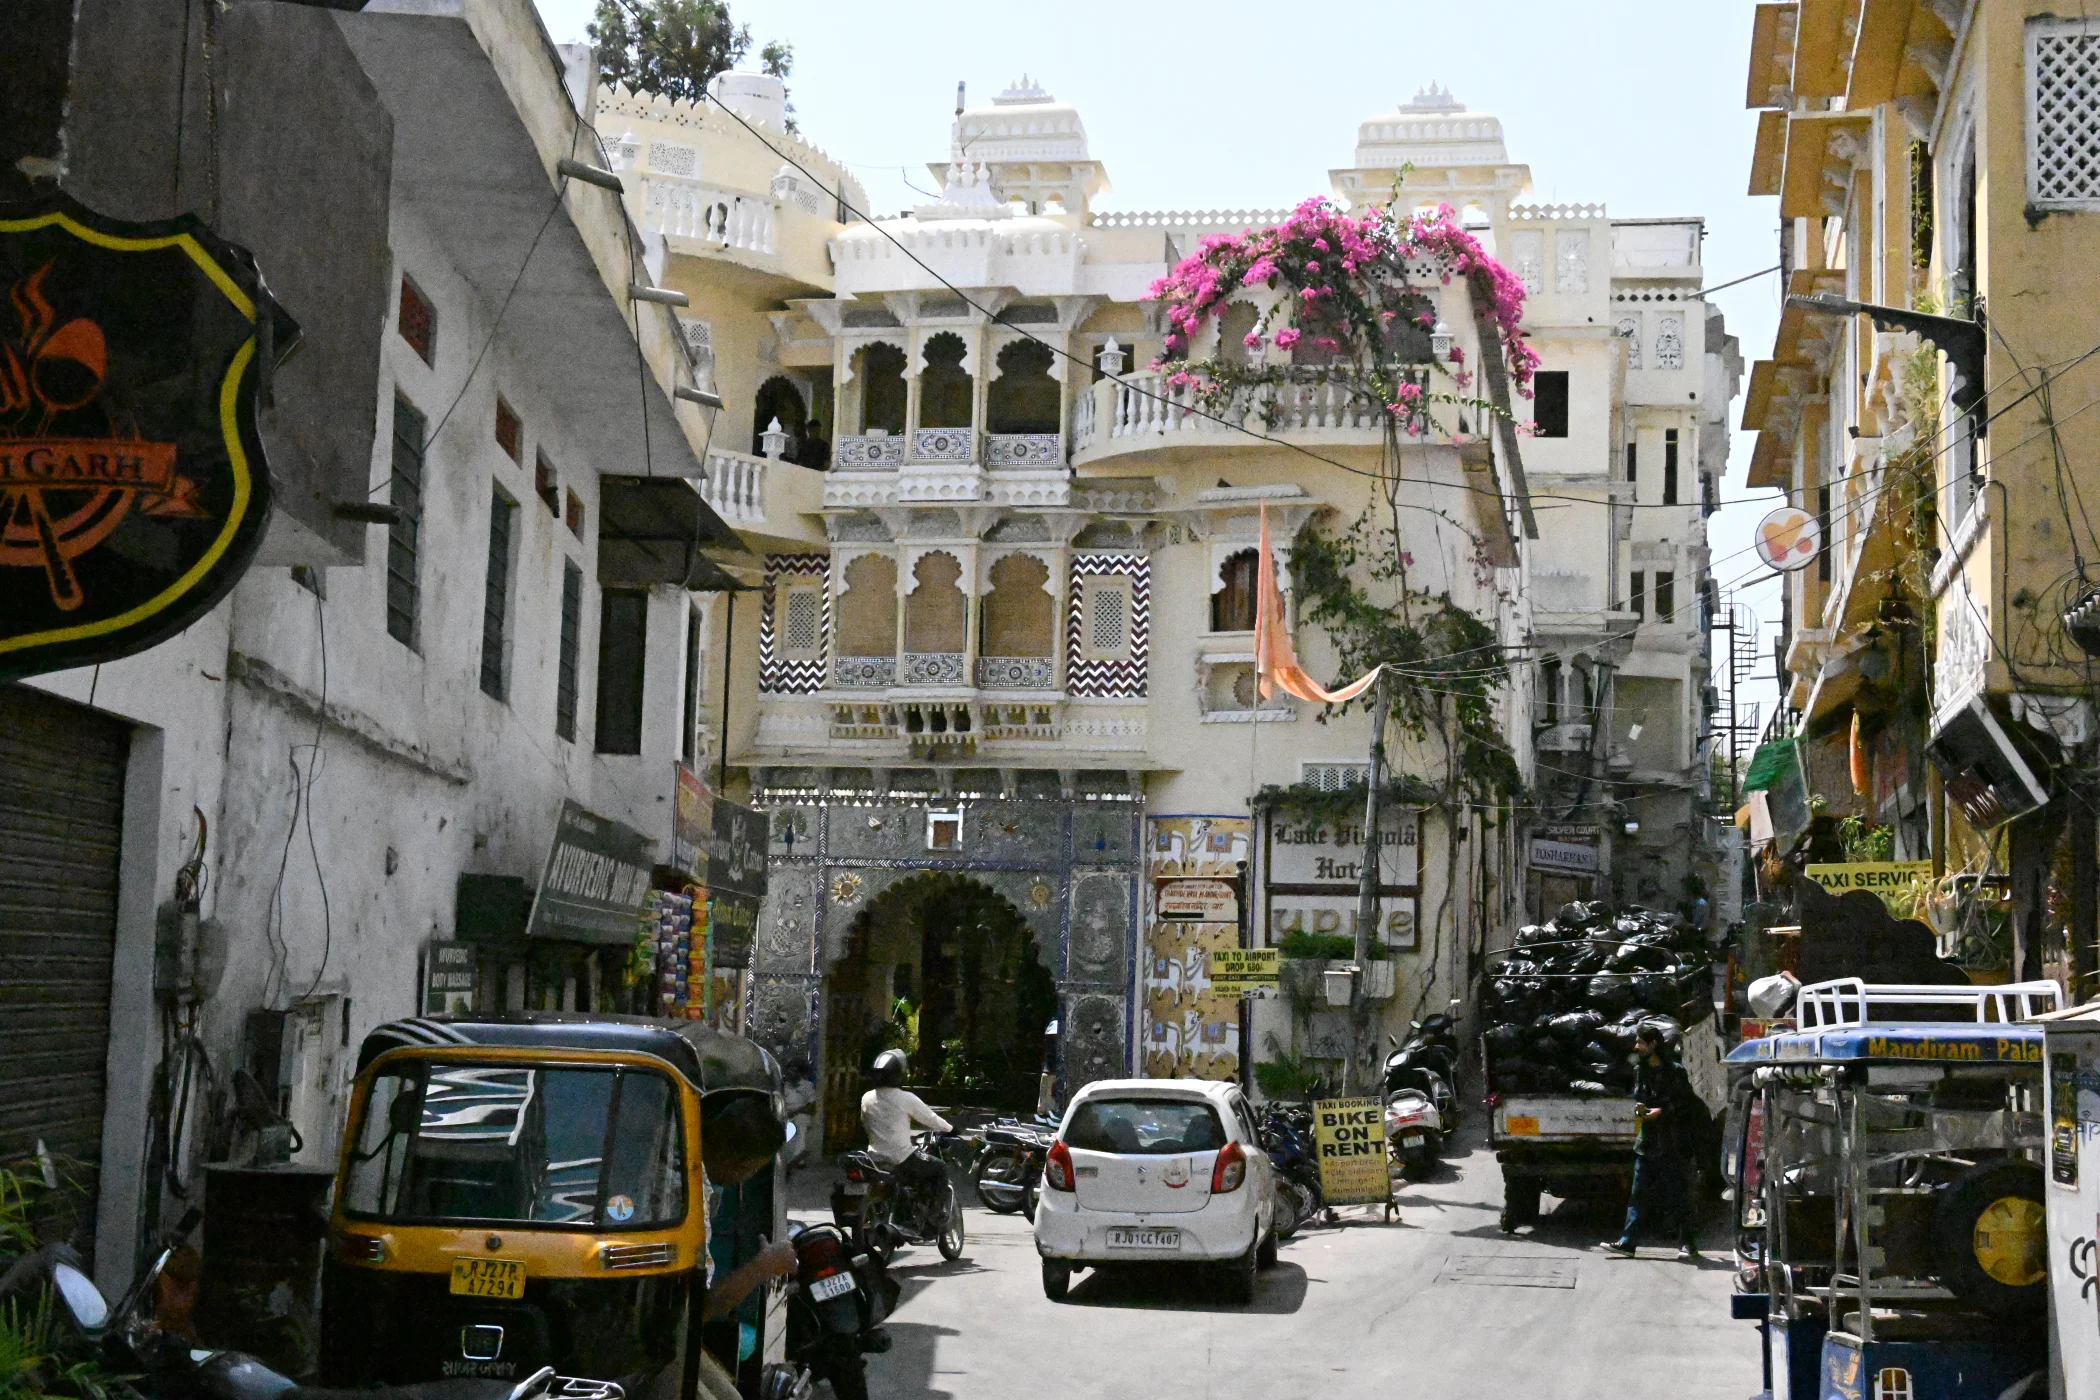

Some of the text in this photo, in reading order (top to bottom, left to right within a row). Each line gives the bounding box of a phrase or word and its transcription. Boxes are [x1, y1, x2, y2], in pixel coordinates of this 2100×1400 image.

[1275, 823, 1328, 845] Lake
[1315, 856, 1367, 880] Hot
[1810, 870, 1931, 888] TAXI SERVICE
[1213, 952, 1276, 962] TAXI TO AIRPORT
[1225, 963, 1245, 972] DROP
[1868, 1037, 2044, 1061] Mandiram Pala
[1316, 1099, 1379, 1110] TAXI BOOKING
[1322, 1111, 1379, 1127] BIKE
[1334, 1127, 1369, 1142] ON
[1322, 1140, 1385, 1157] RENT
[1115, 1233, 1179, 1246] RJ01CC1407
